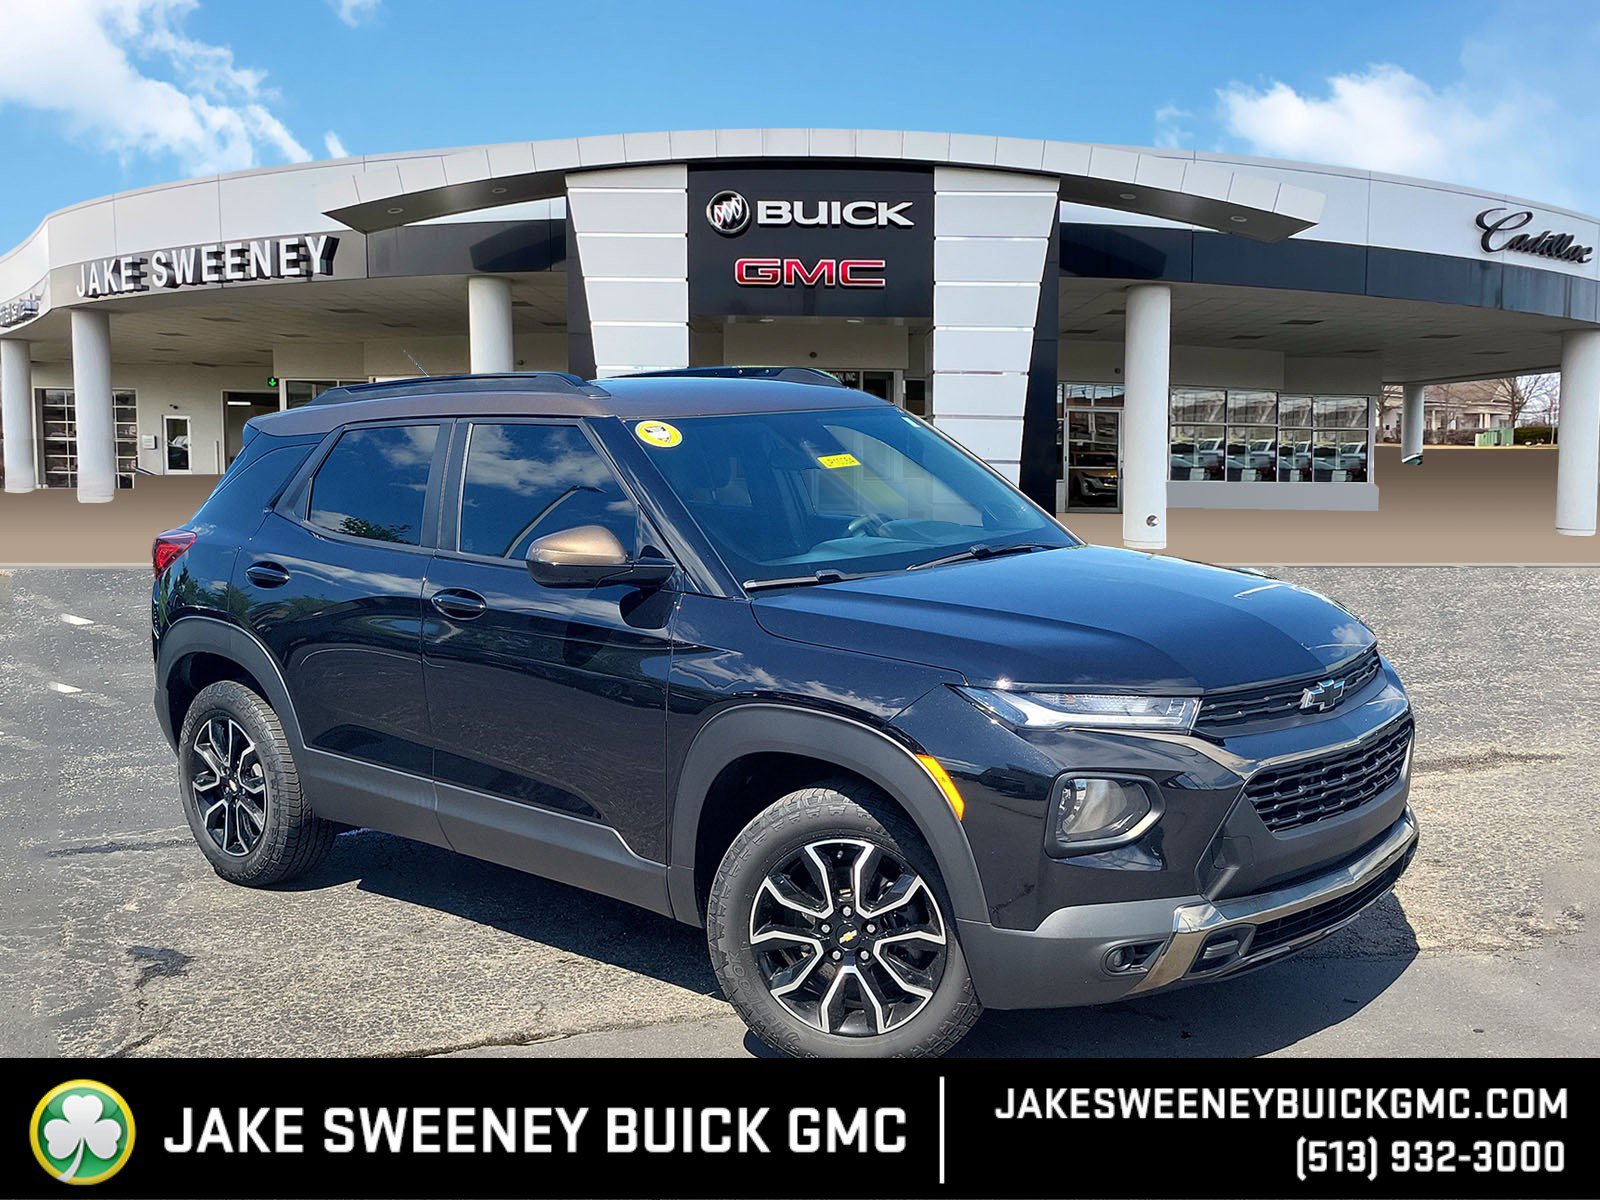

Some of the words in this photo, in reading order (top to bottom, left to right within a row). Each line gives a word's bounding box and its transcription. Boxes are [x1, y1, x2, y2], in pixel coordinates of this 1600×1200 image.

[757, 200, 915, 226] BUICK
[1475, 207, 1593, 263] Cadillac
[76, 254, 140, 298] JAKE
[151, 235, 334, 288] SWEENEY
[734, 258, 886, 287] GMC
